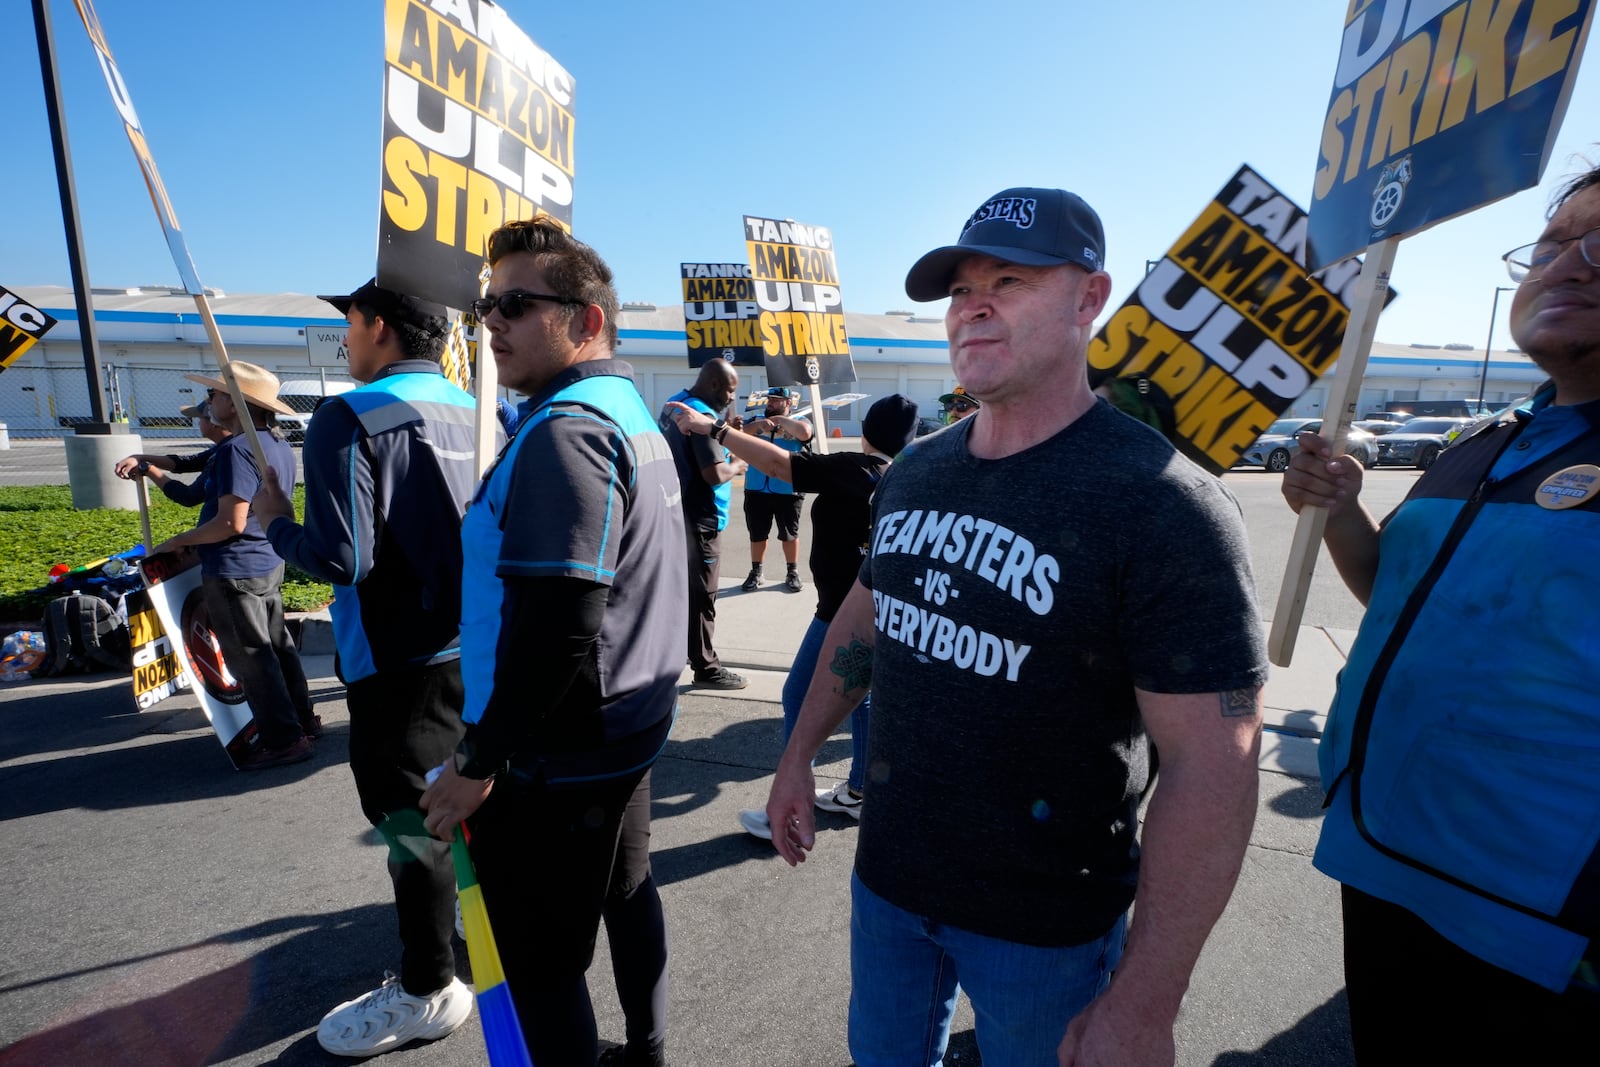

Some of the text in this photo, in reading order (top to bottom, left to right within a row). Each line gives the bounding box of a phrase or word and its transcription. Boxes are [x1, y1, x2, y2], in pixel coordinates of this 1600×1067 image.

[398, 1, 569, 165] AMAZON
[424, 0, 572, 106] ANNC
[1314, 0, 1580, 201] STRIKE
[387, 66, 573, 206] ULP
[747, 218, 831, 249] TANNC
[755, 244, 837, 284] AMAZON
[317, 334, 340, 343] VAN
[685, 302, 759, 321] ULP
[755, 280, 841, 313] ULP
[760, 311, 850, 357] STRIKE
[1138, 257, 1310, 400] ULP
[1176, 213, 1350, 370] AMAZON
[1087, 304, 1280, 471] STRIKE
[872, 510, 1060, 616] TEAMSTERS
[133, 637, 172, 668] LP
